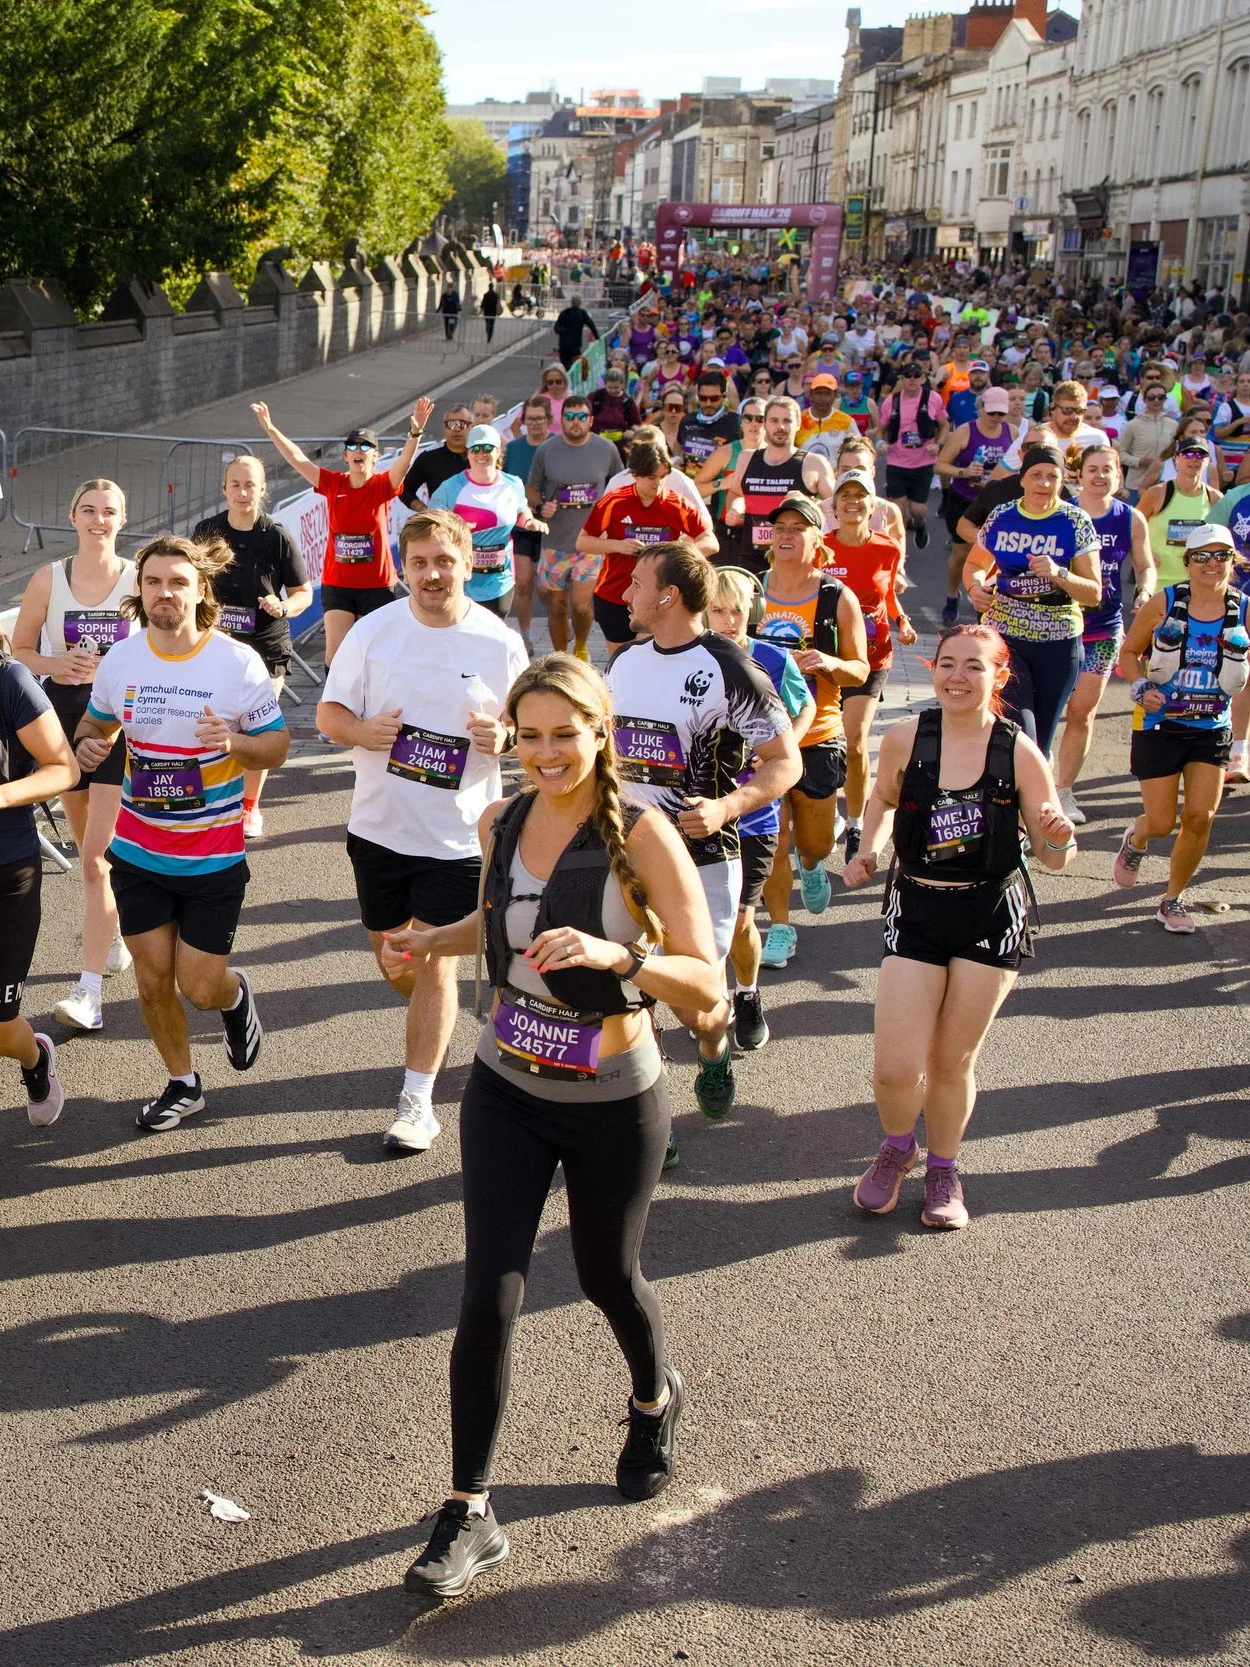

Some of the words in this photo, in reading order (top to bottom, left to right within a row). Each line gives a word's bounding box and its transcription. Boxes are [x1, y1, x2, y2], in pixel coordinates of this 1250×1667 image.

[635, 533, 660, 542] HELEN
[337, 541, 371, 549] GEORGINA
[994, 531, 1065, 557] RSPCA.
[341, 548, 364, 556] 21429
[1021, 586, 1051, 595] 21225
[220, 613, 251, 624] ORGINA
[756, 611, 813, 638] NTERNATIONAL
[77, 623, 118, 633] SOPHIE
[1030, 620, 1060, 632] RSPCA
[1006, 625, 1039, 640] RSPCA
[140, 685, 177, 695] ymchwil
[179, 688, 214, 699] canser
[138, 696, 166, 704] cymru
[680, 696, 702, 707] WWF
[136, 706, 166, 714] cancer
[167, 708, 205, 719] research
[1186, 703, 1214, 712] JULIE
[135, 716, 163, 725] wales
[422, 732, 444, 742] CARDIFF
[631, 733, 664, 748] LUKE
[414, 743, 446, 760] LIAM
[628, 746, 666, 761] 24540
[408, 754, 447, 773] 24640
[153, 774, 174, 785] JAY
[147, 786, 184, 797] 18536
[930, 808, 983, 829] AMELIA
[936, 821, 979, 842] 16897
[529, 999, 557, 1014] CARDIFF
[558, 1009, 580, 1018] HALF
[509, 1012, 580, 1044] JOANNE
[511, 1031, 568, 1060] 24577
